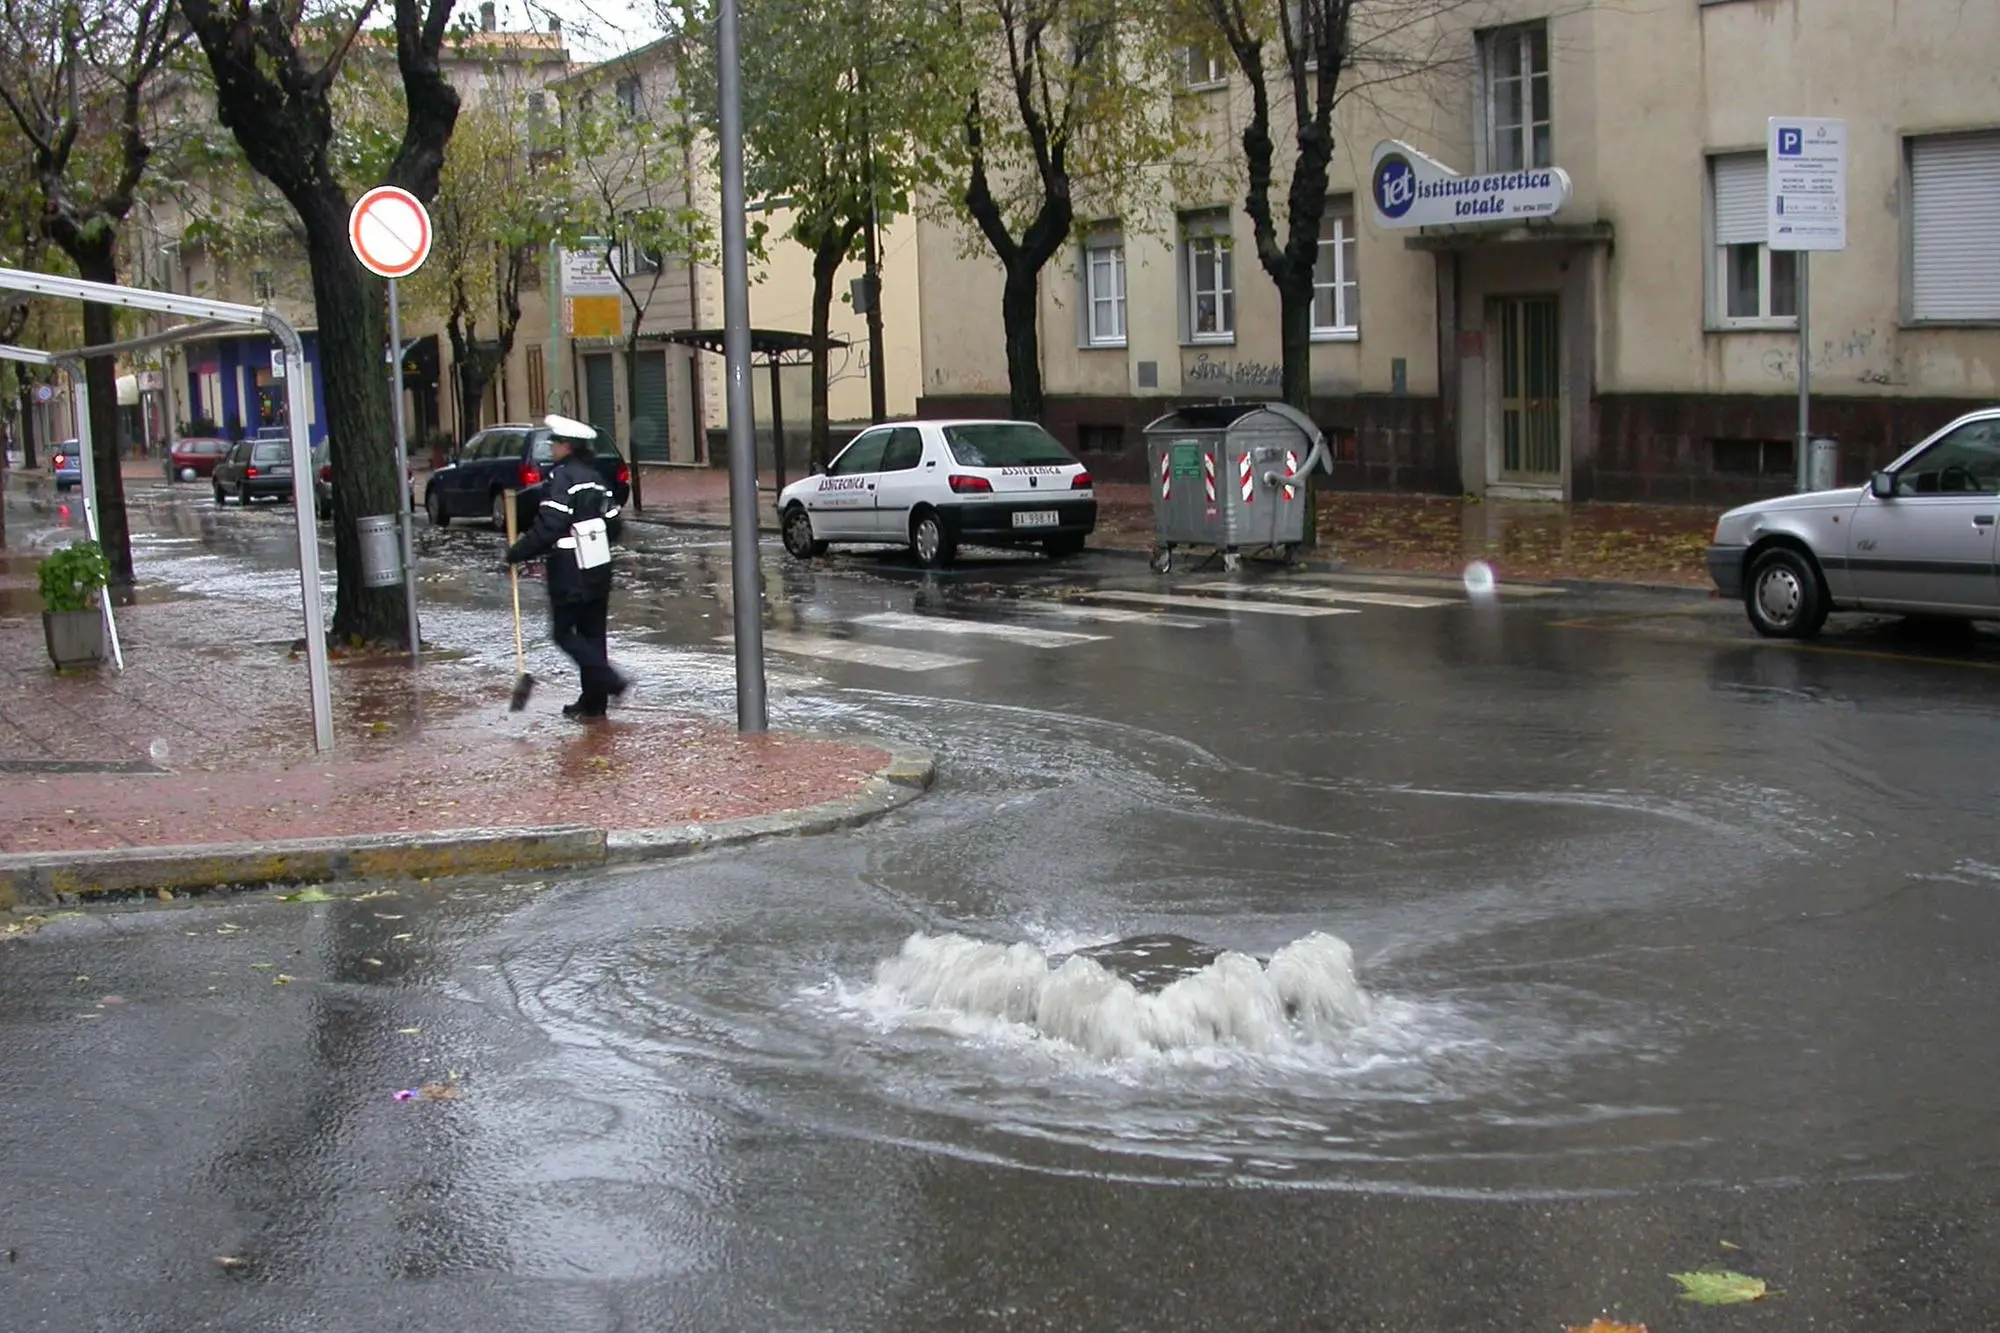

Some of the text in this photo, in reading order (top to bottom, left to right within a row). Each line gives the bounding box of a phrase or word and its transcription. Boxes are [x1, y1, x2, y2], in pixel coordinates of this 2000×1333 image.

[1784, 132, 1797, 151] P
[1417, 170, 1550, 199] istituto estetica
[1455, 195, 1505, 216] totale
